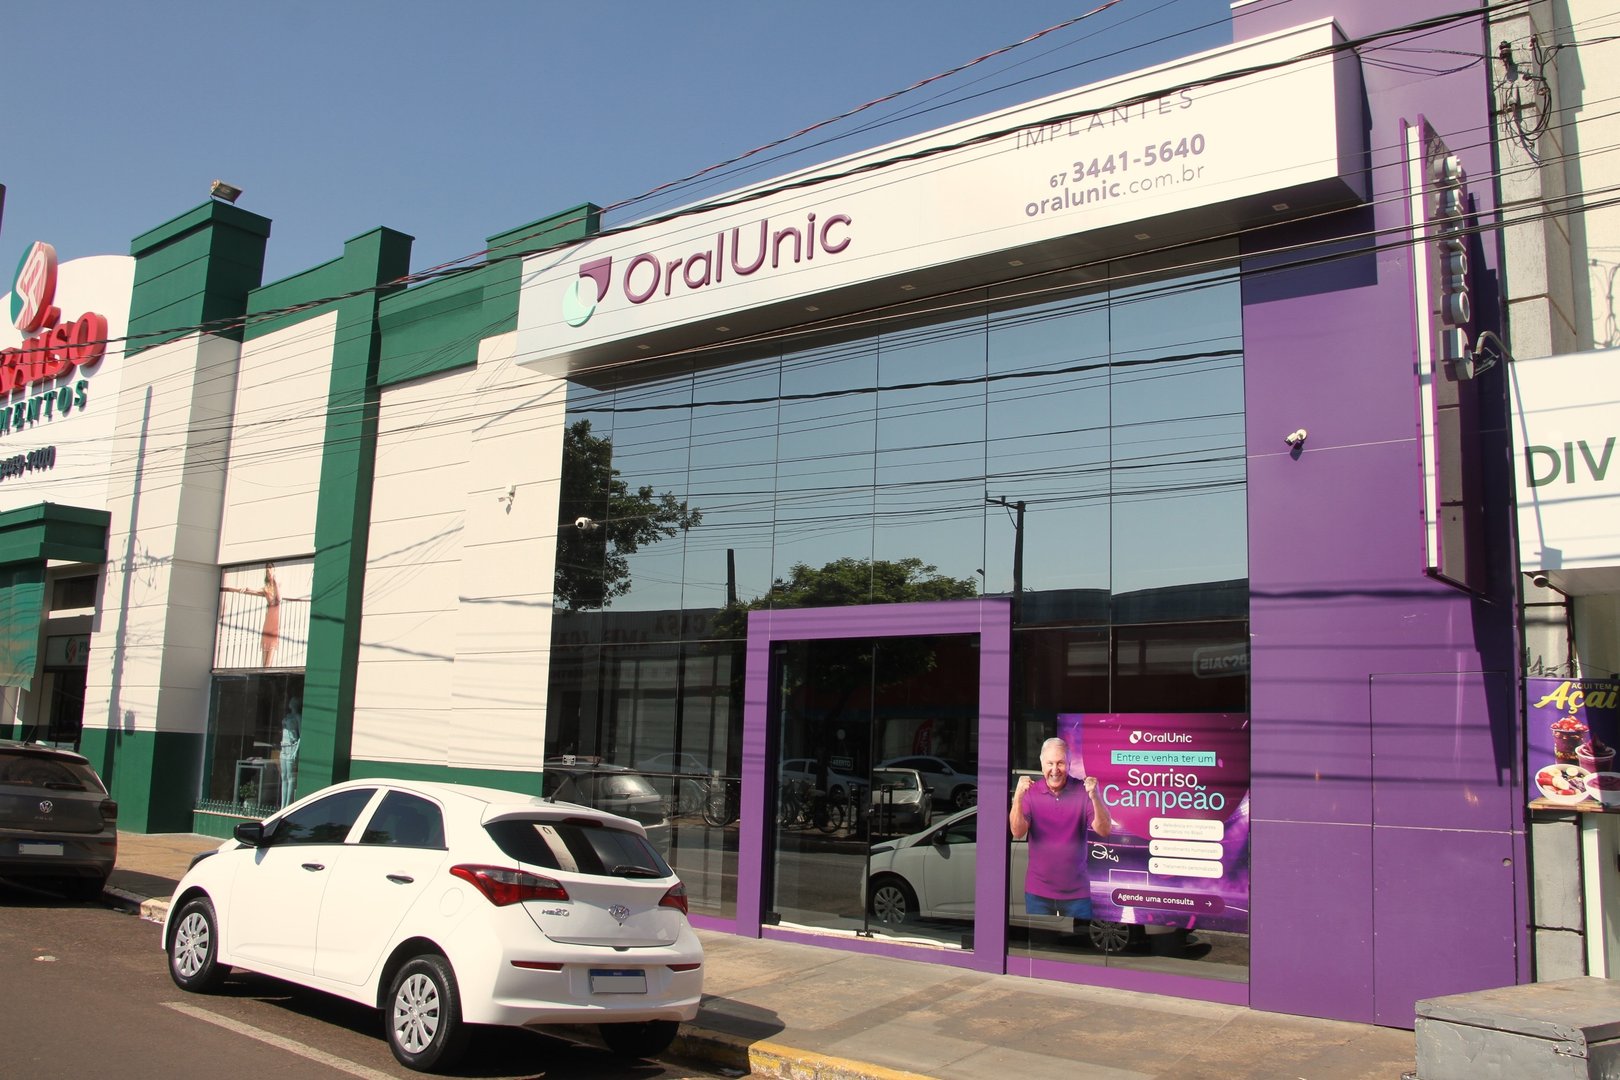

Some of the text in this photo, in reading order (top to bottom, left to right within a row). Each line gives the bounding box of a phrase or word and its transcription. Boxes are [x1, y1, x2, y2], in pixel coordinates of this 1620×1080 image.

[1016, 86, 1193, 150] IMPLANTES
[1050, 133, 1206, 188] 67 3441-5640
[1025, 163, 1205, 217] oralunic.com.br
[623, 212, 852, 304] OralUnic
[1525, 437, 1617, 488] DIV
[1571, 682, 1593, 690] AQUI
[1143, 732, 1193, 743] OralUnic
[1116, 753, 1141, 762] Entre
[1151, 754, 1179, 763] venha
[1181, 755, 1194, 763] ter
[1198, 755, 1214, 763] um
[1127, 768, 1198, 788] Sorriso
[1103, 784, 1225, 815] Campeão
[1117, 893, 1144, 902] Agende
[1162, 897, 1194, 906] consulta
